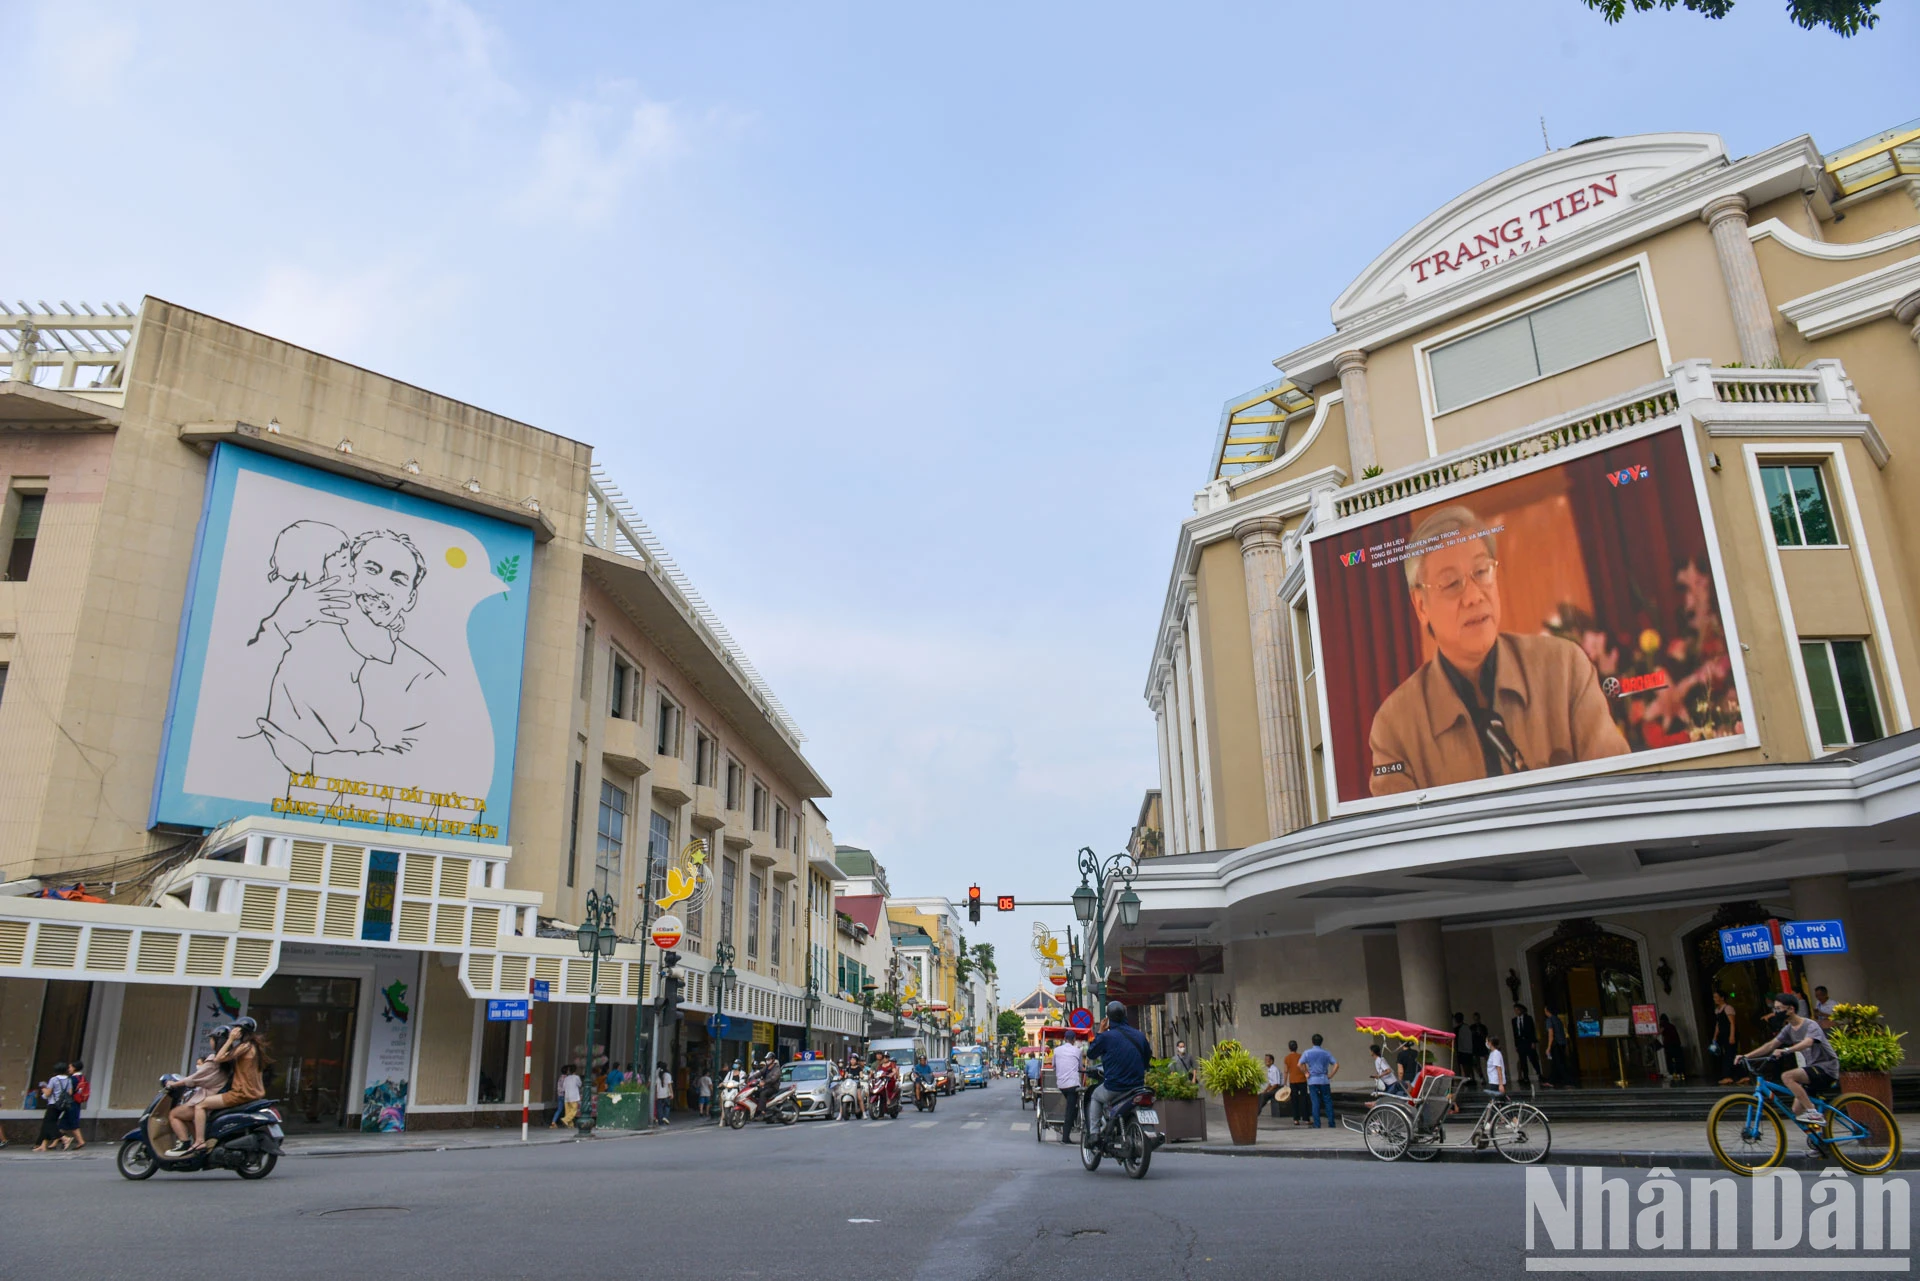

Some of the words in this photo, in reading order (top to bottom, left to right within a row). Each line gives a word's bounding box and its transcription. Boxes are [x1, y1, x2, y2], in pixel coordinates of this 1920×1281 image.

[1411, 217, 1523, 283] TRANG
[1530, 174, 1618, 231] TIEN
[1480, 235, 1547, 272] PLAZA
[1376, 763, 1402, 774] 20:40
[290, 771, 320, 789] XÂY
[371, 783, 394, 802] LẠI
[473, 798, 487, 812] TA
[420, 817, 437, 832] TO
[1000, 898, 1013, 910] 06
[1742, 930, 1758, 939] PHỐ
[1807, 922, 1827, 932] PHỐ
[1727, 942, 1753, 957] TRÀNG
[1752, 937, 1770, 953] TIỀN
[1787, 934, 1820, 949] HÀNG
[1820, 933, 1842, 949] BÀI
[1260, 998, 1343, 1017] BURBERRY
